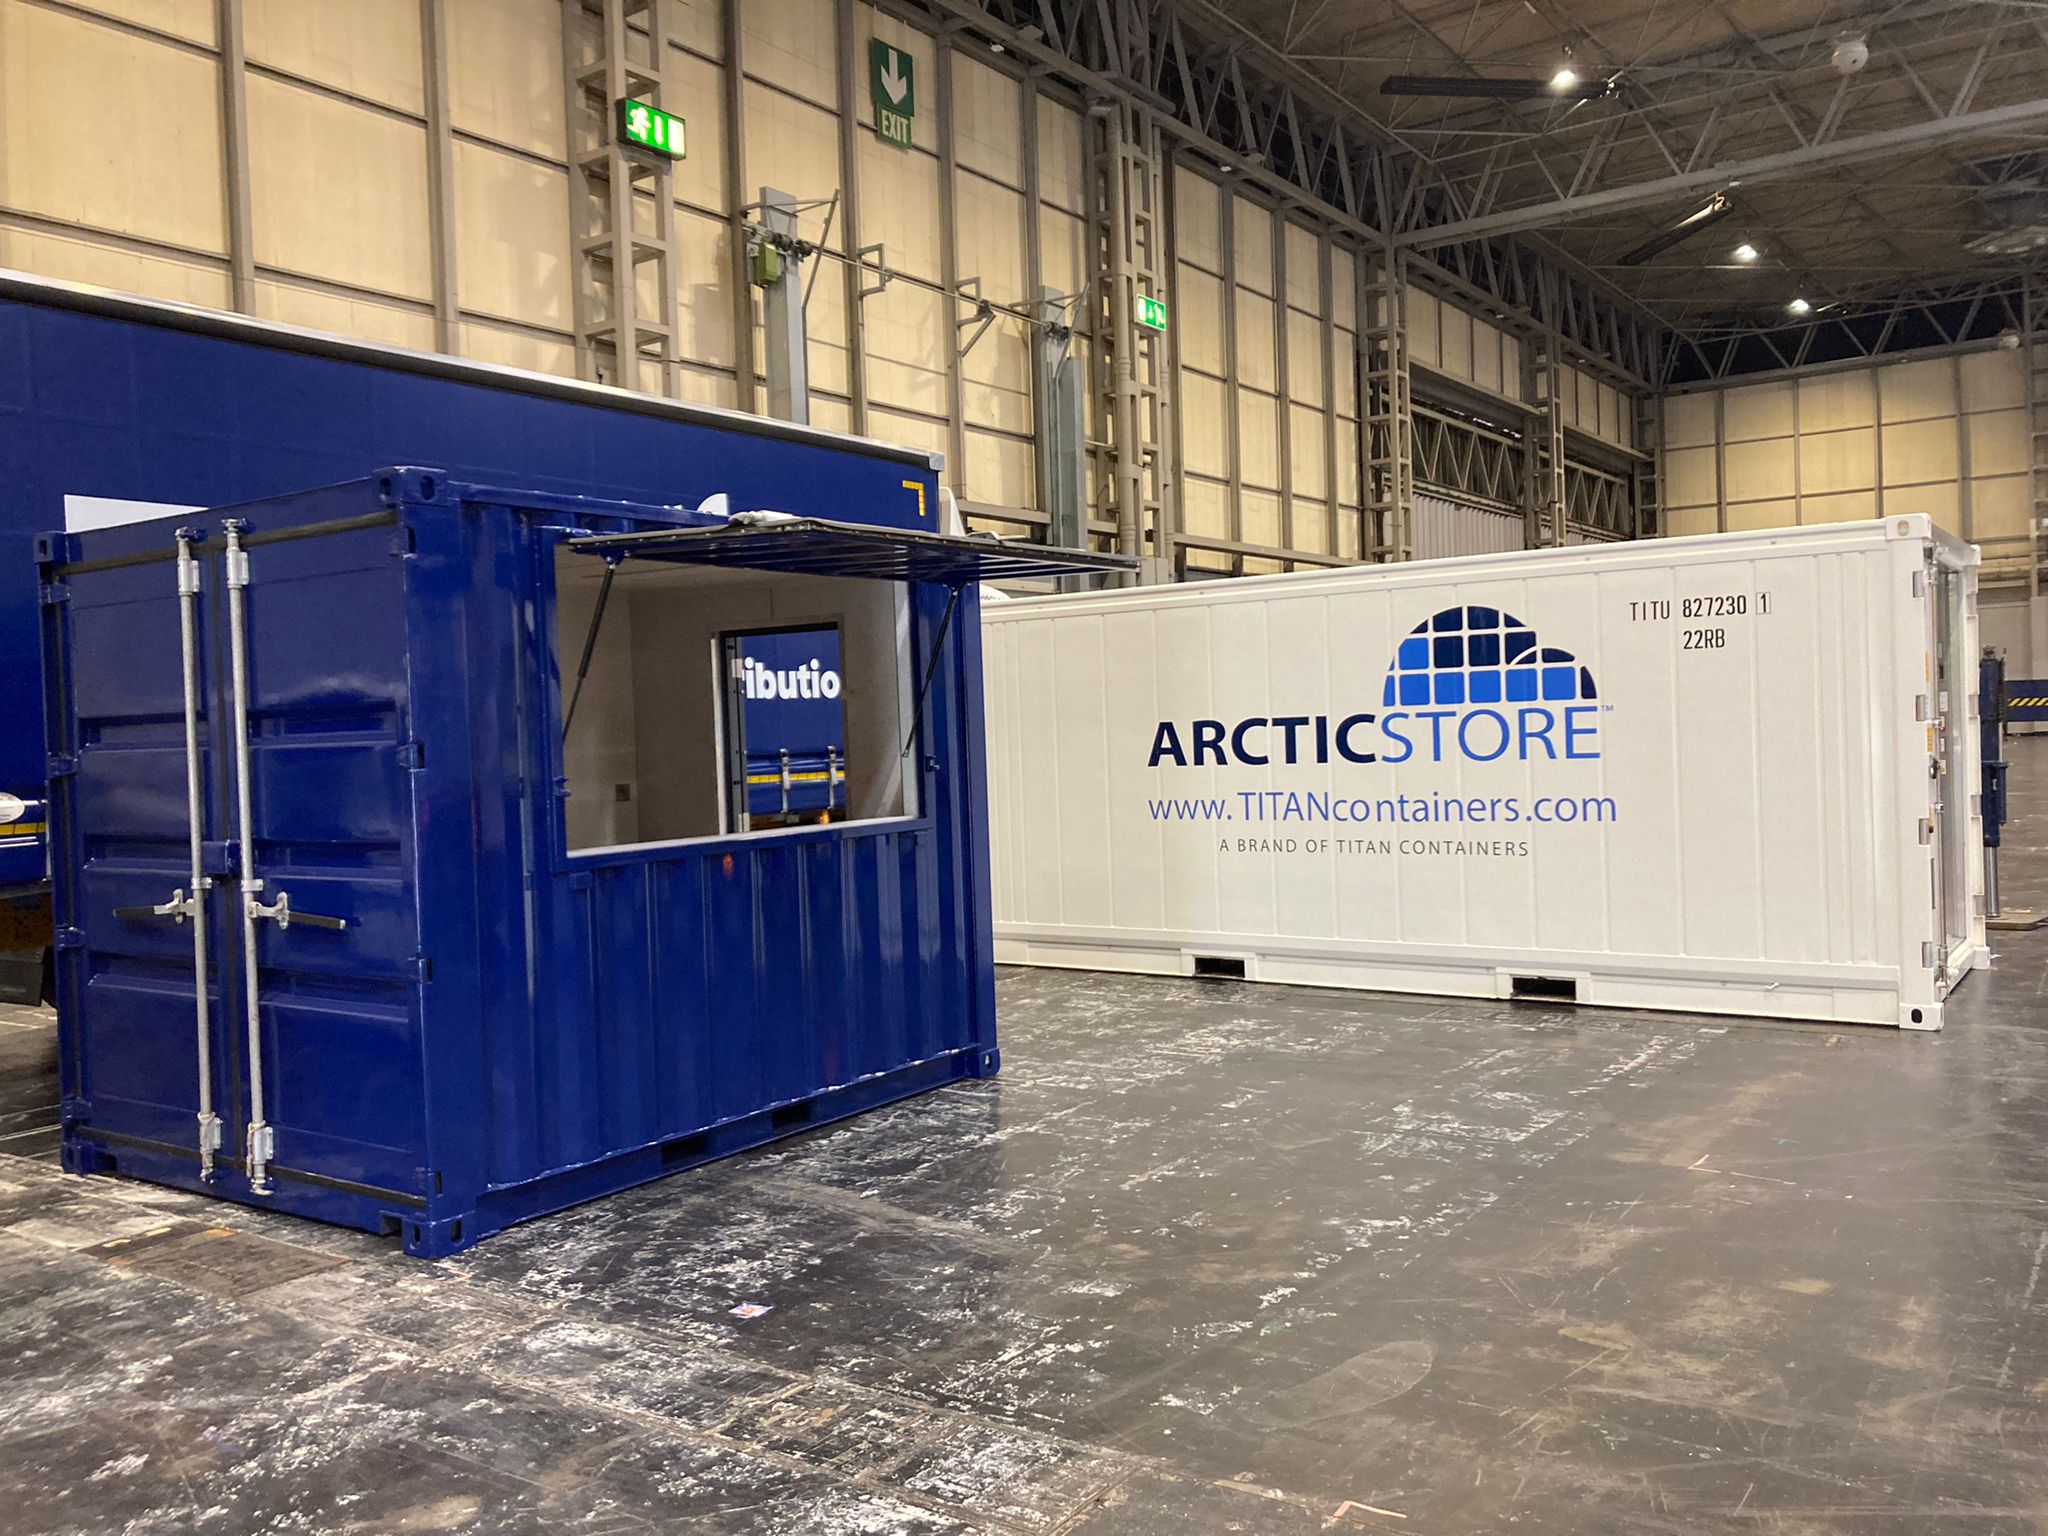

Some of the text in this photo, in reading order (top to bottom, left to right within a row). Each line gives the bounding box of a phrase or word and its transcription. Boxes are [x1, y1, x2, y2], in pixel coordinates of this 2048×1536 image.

[881, 108, 908, 144] EXIT
[1630, 600, 1670, 621] TITU
[1682, 595, 1747, 618] 827230
[1683, 628, 1725, 649] 22RB
[742, 656, 840, 699] ibutio
[1147, 706, 1600, 767] ARCTICSTORE
[1148, 791, 1617, 823] www.TITANcontainers.com
[1219, 838, 1529, 857] A BRAND OF TITAN CONTAINERS
